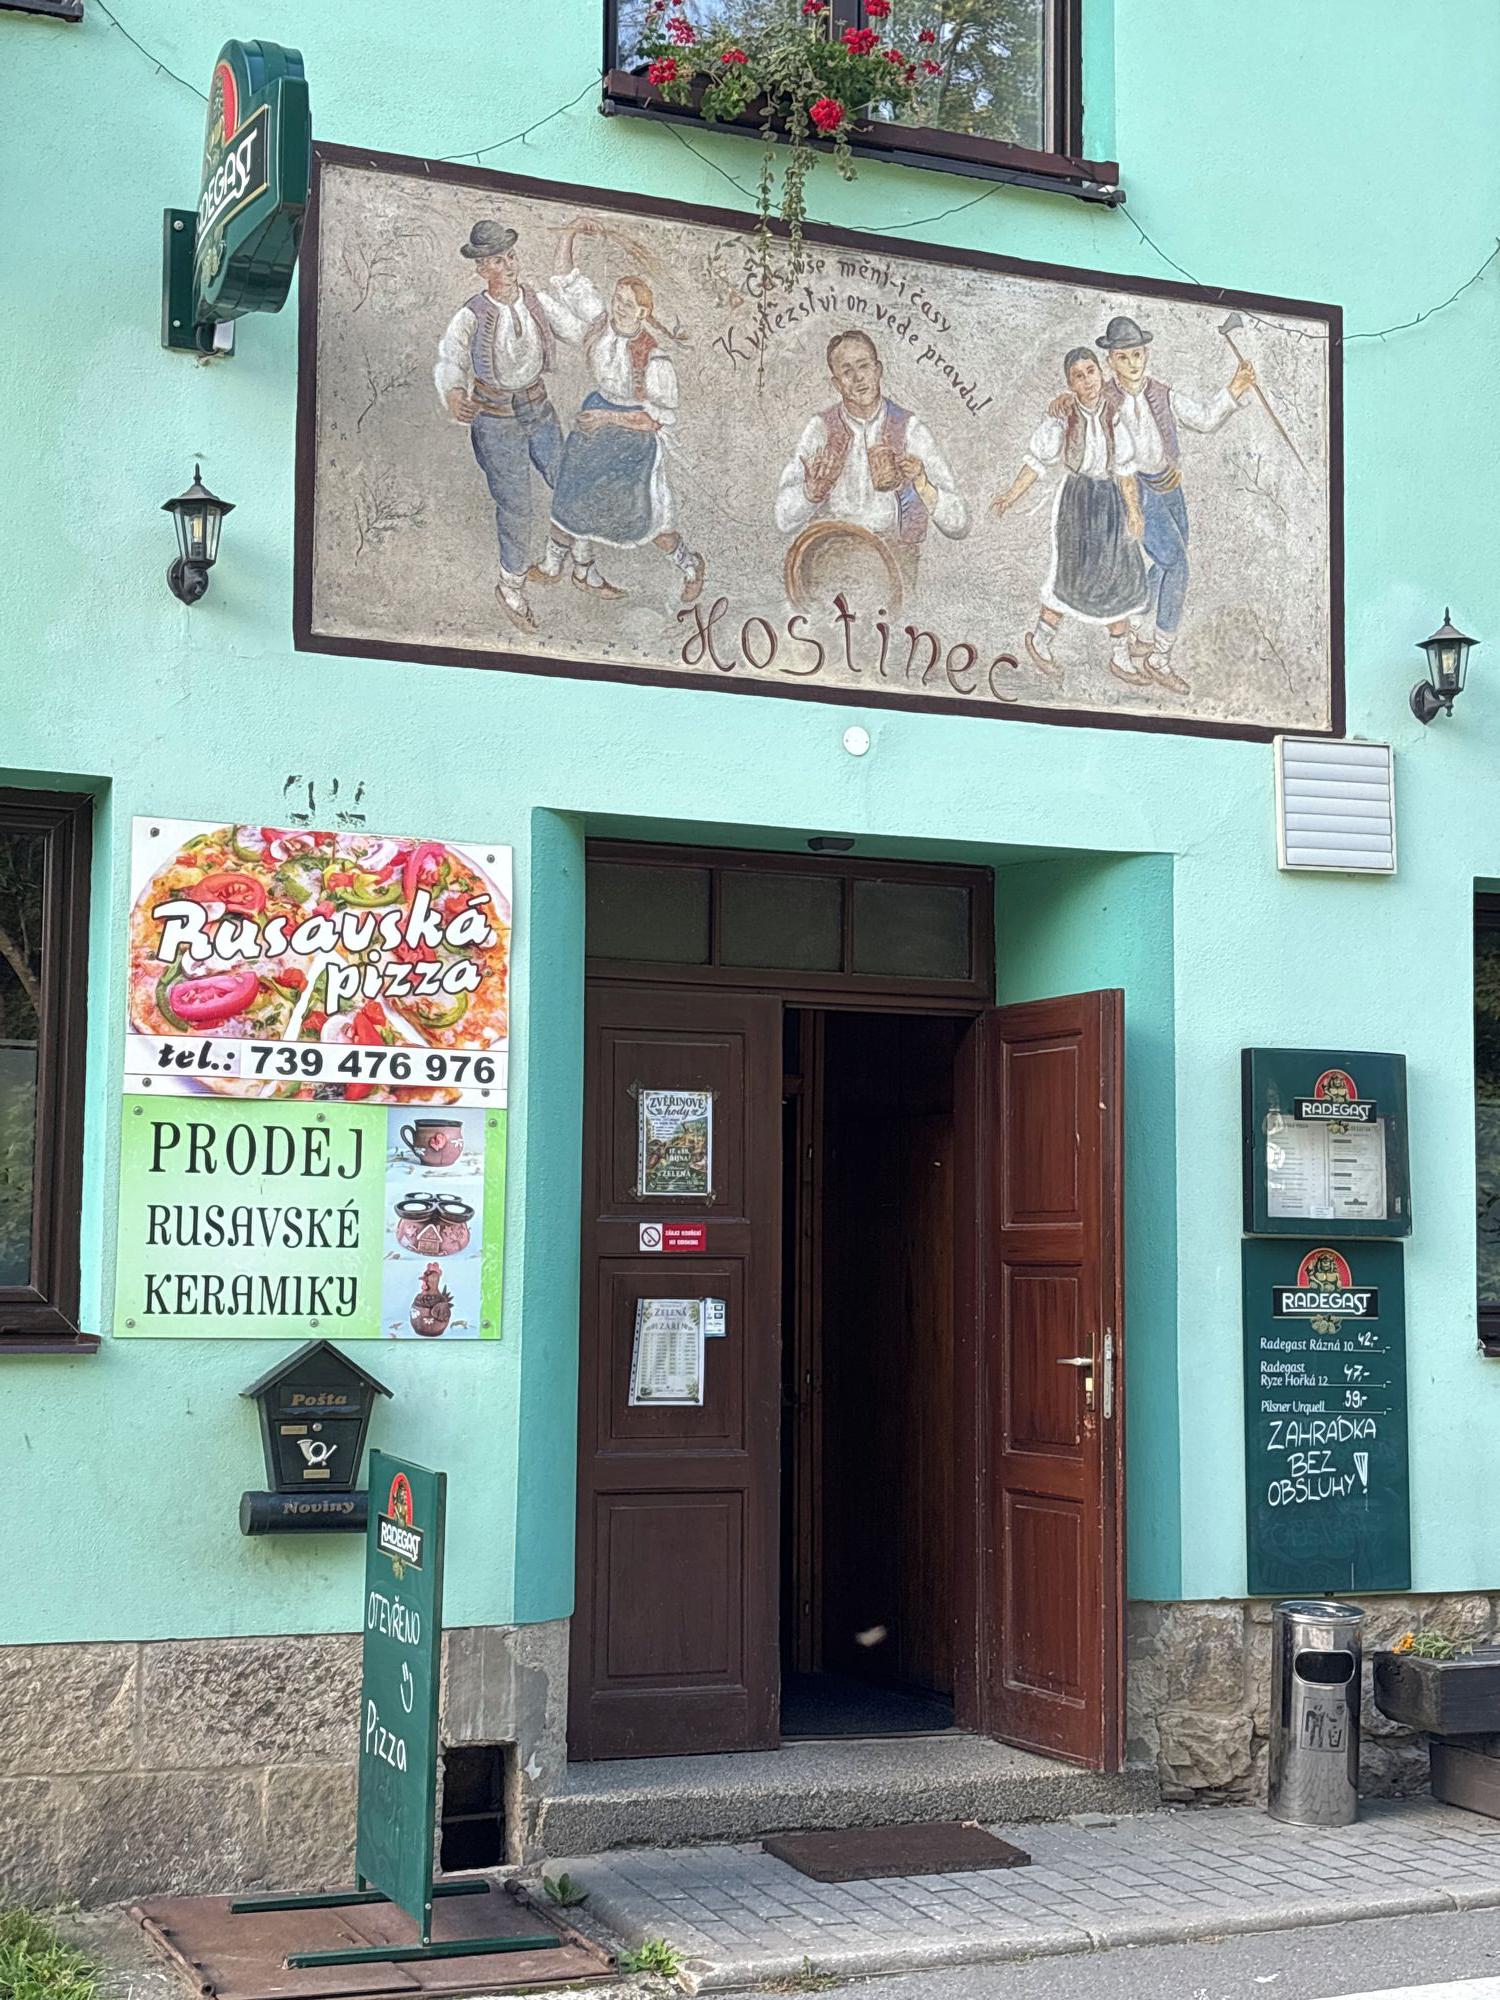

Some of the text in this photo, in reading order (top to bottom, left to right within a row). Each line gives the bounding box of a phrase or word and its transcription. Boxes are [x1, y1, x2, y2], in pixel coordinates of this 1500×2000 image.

[197, 127, 258, 236] DEGAST
[847, 294, 868, 313] on
[876, 303, 919, 346] vede
[911, 287, 951, 333] časy
[677, 592, 1019, 702] Hostinec
[152, 888, 495, 965] Rusavská
[324, 954, 484, 1016] pizza
[158, 1041, 495, 1084] tel.: 739 476 976
[664, 1105, 690, 1120] hody
[1302, 1102, 1372, 1121] RADEGAST
[149, 1121, 363, 1179] PRODEJ
[146, 1199, 360, 1249] RUSAVSKÉ
[143, 1273, 359, 1317] KERAMIKY
[1282, 1292, 1371, 1315] RADEGAST
[1260, 1337, 1306, 1353] Radegast
[1309, 1338, 1341, 1351] Rázná
[1343, 1341, 1354, 1351] 10
[1260, 1361, 1305, 1376] Radegast
[1260, 1375, 1282, 1389] Ryze
[1285, 1374, 1316, 1387] Hořká
[1318, 1376, 1329, 1386] 12
[291, 1393, 347, 1407] Pošta
[1261, 1400, 1292, 1413] Pilsner
[1293, 1401, 1325, 1415] Urquell
[1287, 1450, 1337, 1477] BEZ
[283, 1500, 355, 1514] Noviny
[380, 1521, 421, 1562] RADEGAST
[367, 1591, 421, 1646] OTEVŘENO
[365, 1699, 408, 1773] Pizza
